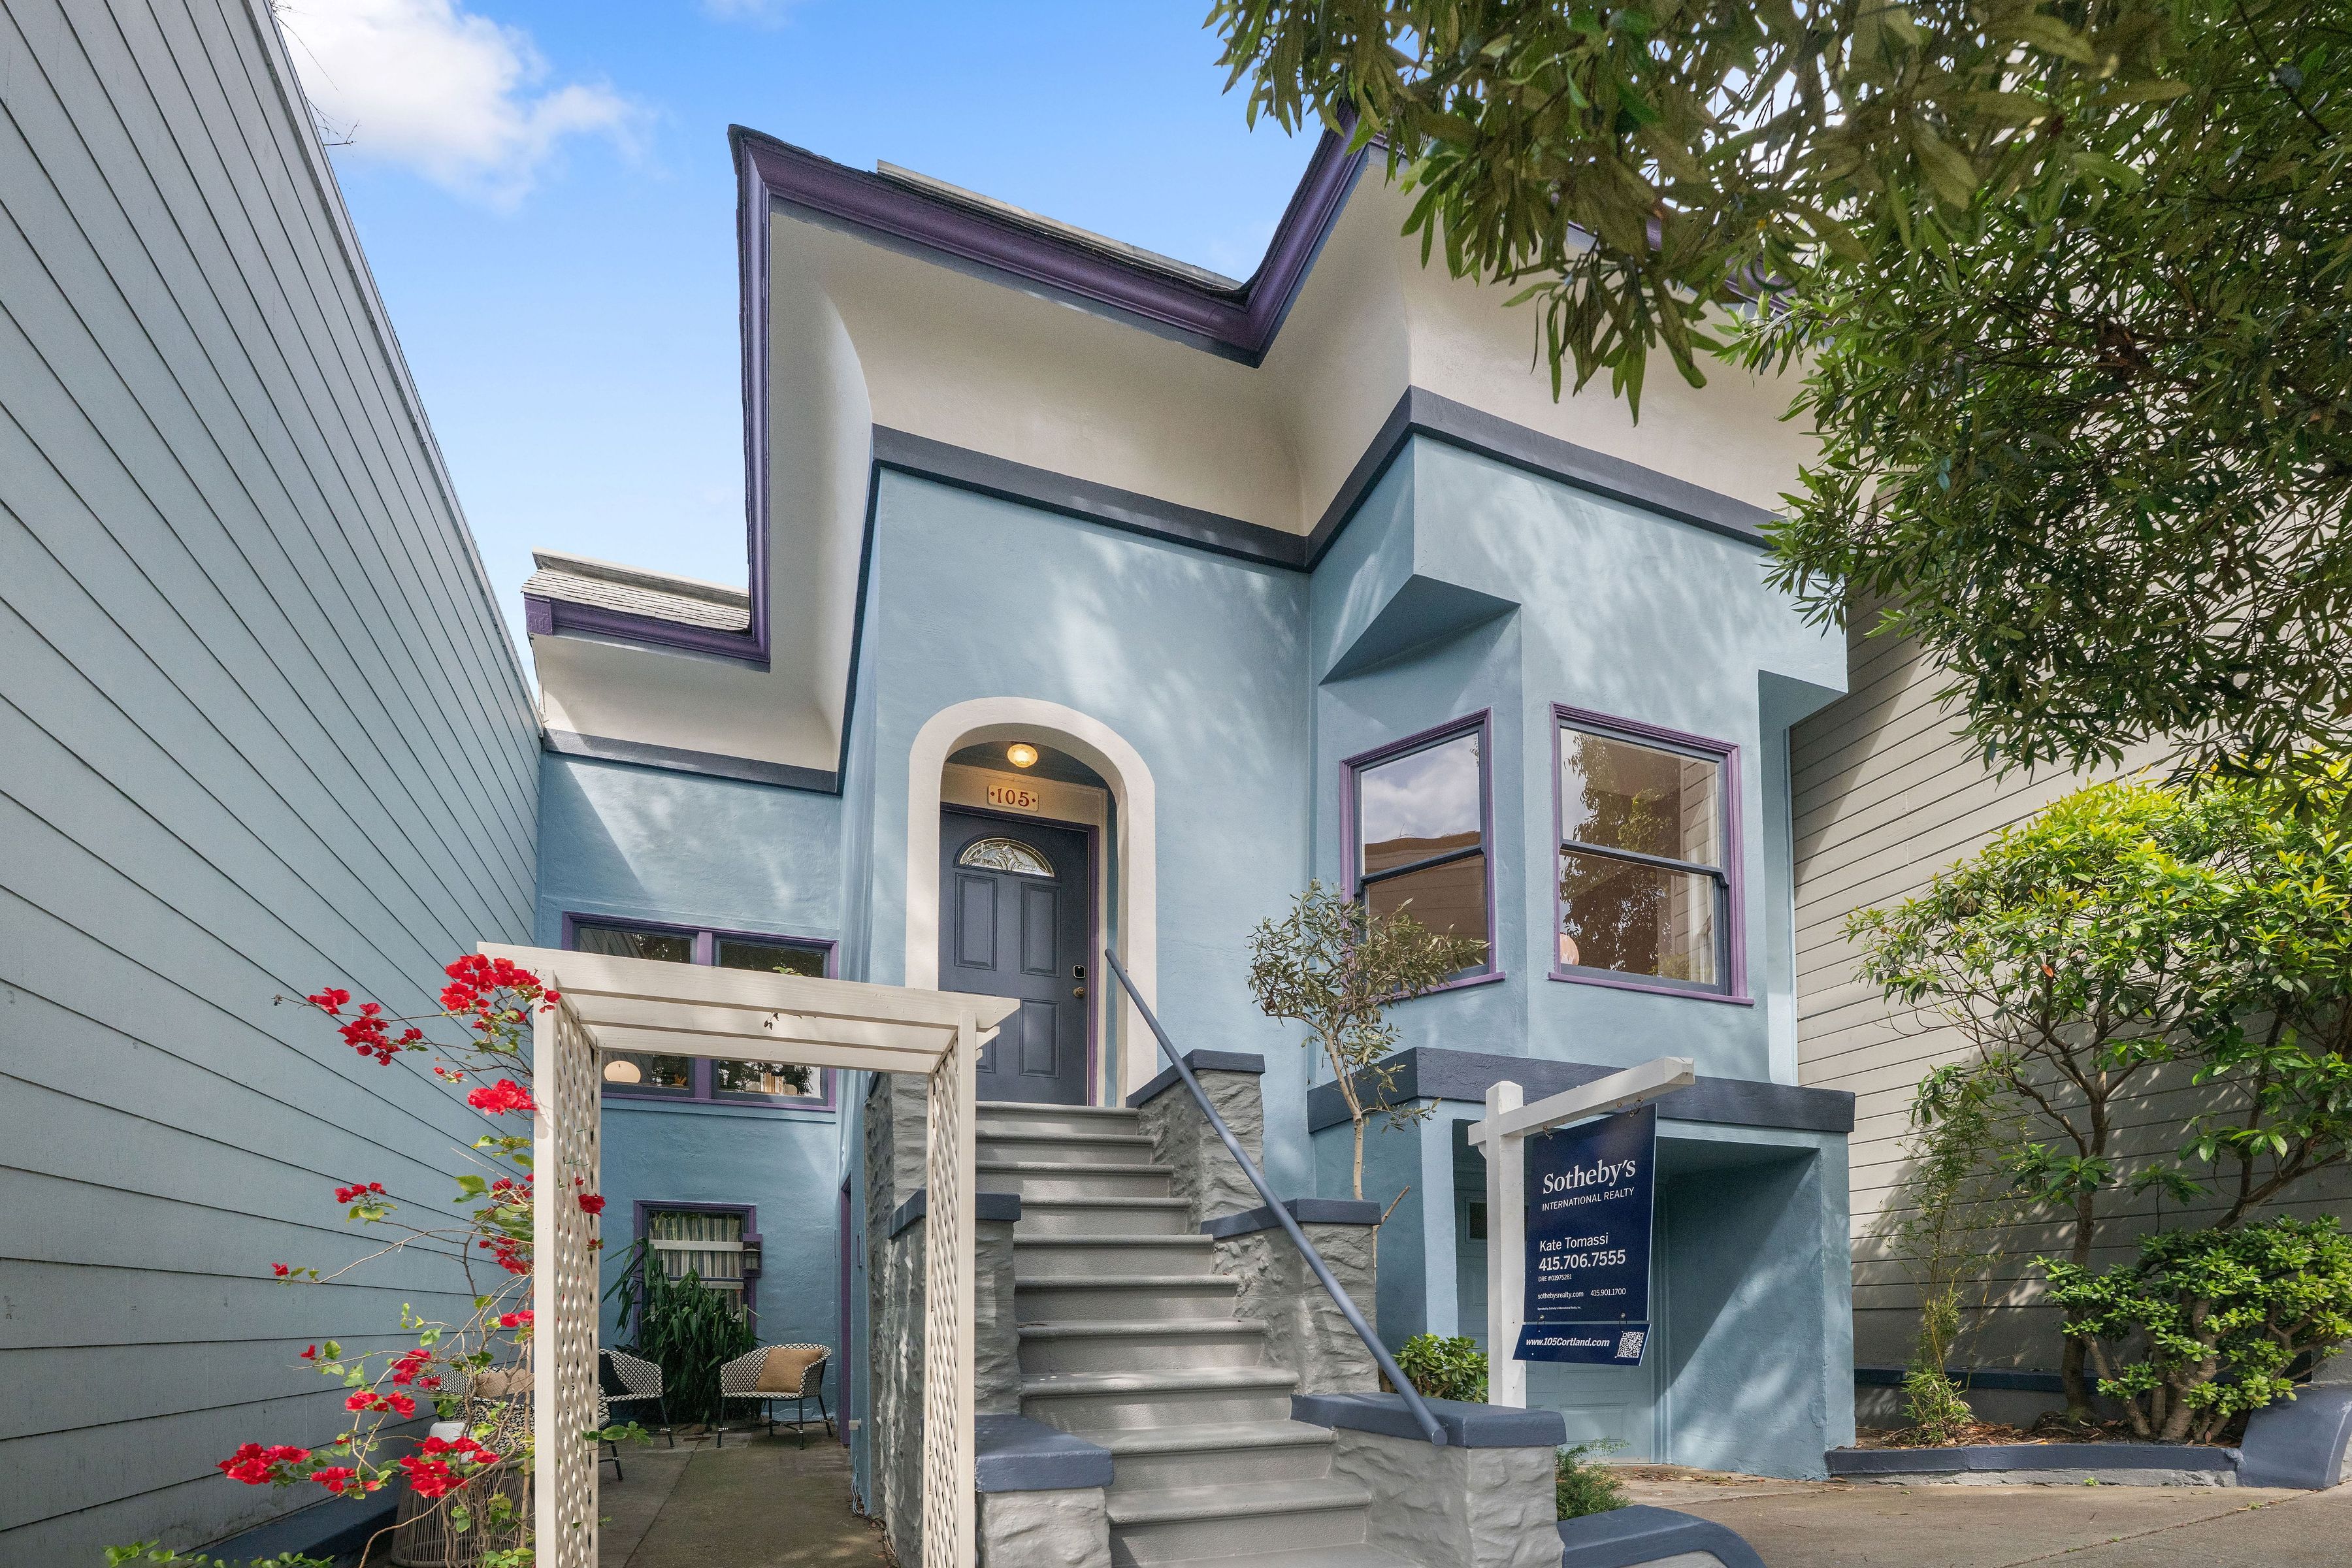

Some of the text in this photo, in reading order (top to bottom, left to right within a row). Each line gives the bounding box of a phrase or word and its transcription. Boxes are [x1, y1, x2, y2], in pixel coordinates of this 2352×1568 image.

[997, 788, 1030, 807] 105
[1543, 1159, 1636, 1194] Sotheby's
[1542, 1187, 1635, 1211] INTERNATIONAL REALTY
[1540, 1232, 1609, 1252] Kate Tomassi
[1539, 1249, 1626, 1271] 415.706.7555
[1537, 1288, 1627, 1300] sothebysrealty.com 415.901.1700
[1526, 1337, 1610, 1347] www.105Cortland.com
